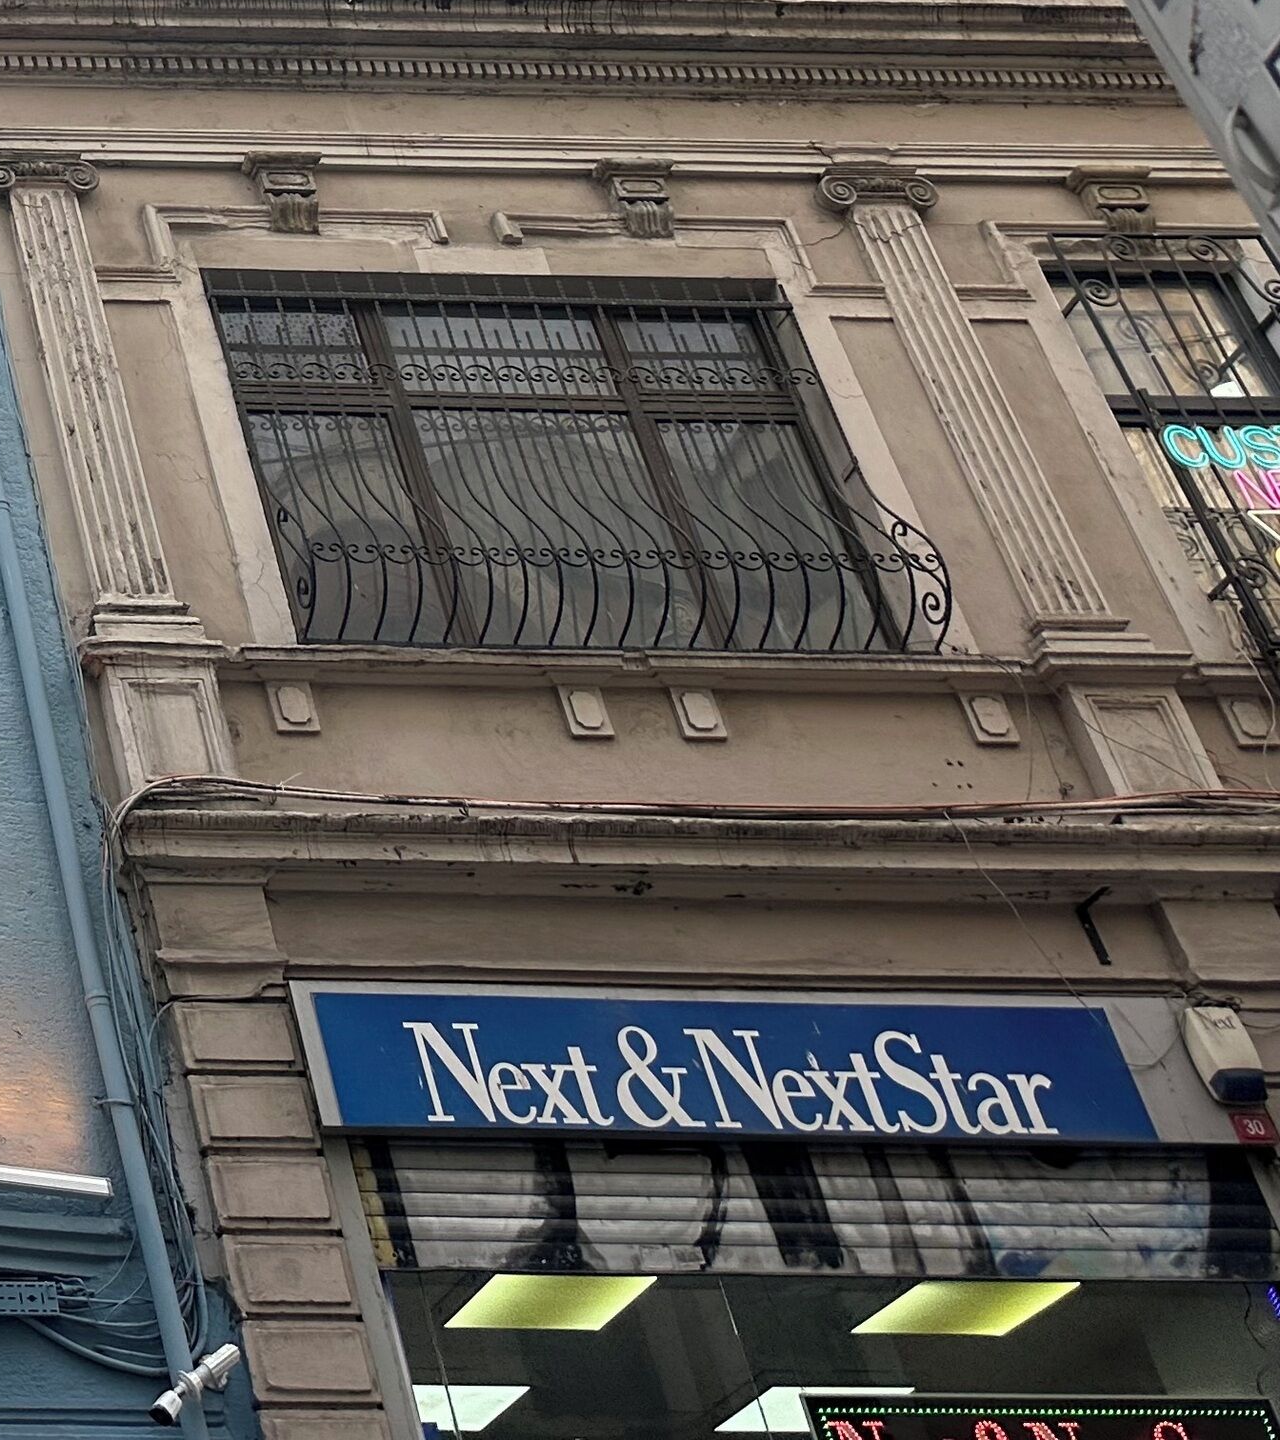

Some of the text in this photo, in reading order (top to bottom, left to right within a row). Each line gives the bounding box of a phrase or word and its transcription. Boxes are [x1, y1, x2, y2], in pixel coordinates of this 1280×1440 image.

[1163, 425, 1280, 469] CUS
[403, 1022, 1060, 1135] Next & NextStar
[1243, 1119, 1265, 1135] 30
